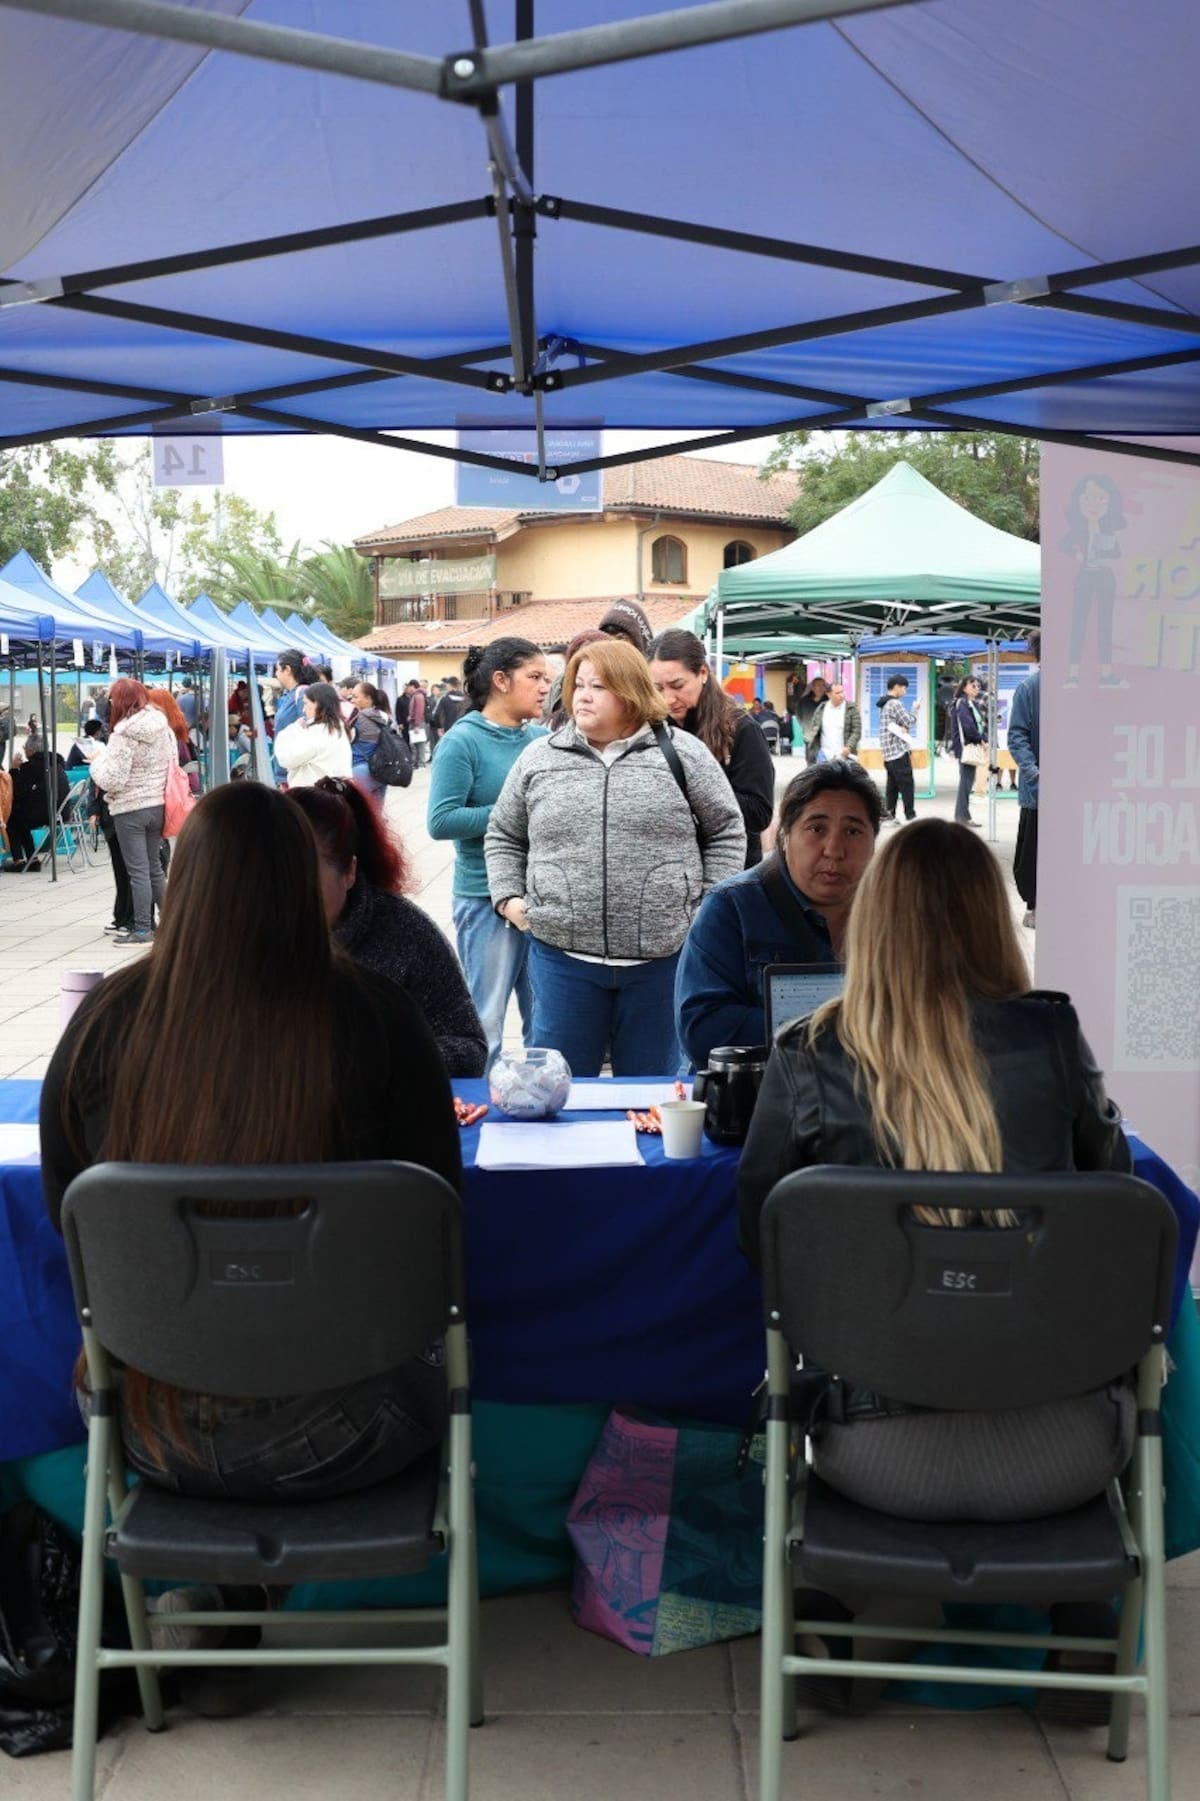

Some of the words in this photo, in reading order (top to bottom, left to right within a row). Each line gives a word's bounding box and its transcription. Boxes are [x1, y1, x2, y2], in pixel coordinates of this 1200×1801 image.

[415, 569, 429, 585] DE
[225, 1264, 260, 1280] ESC
[943, 1269, 977, 1290] ESC
